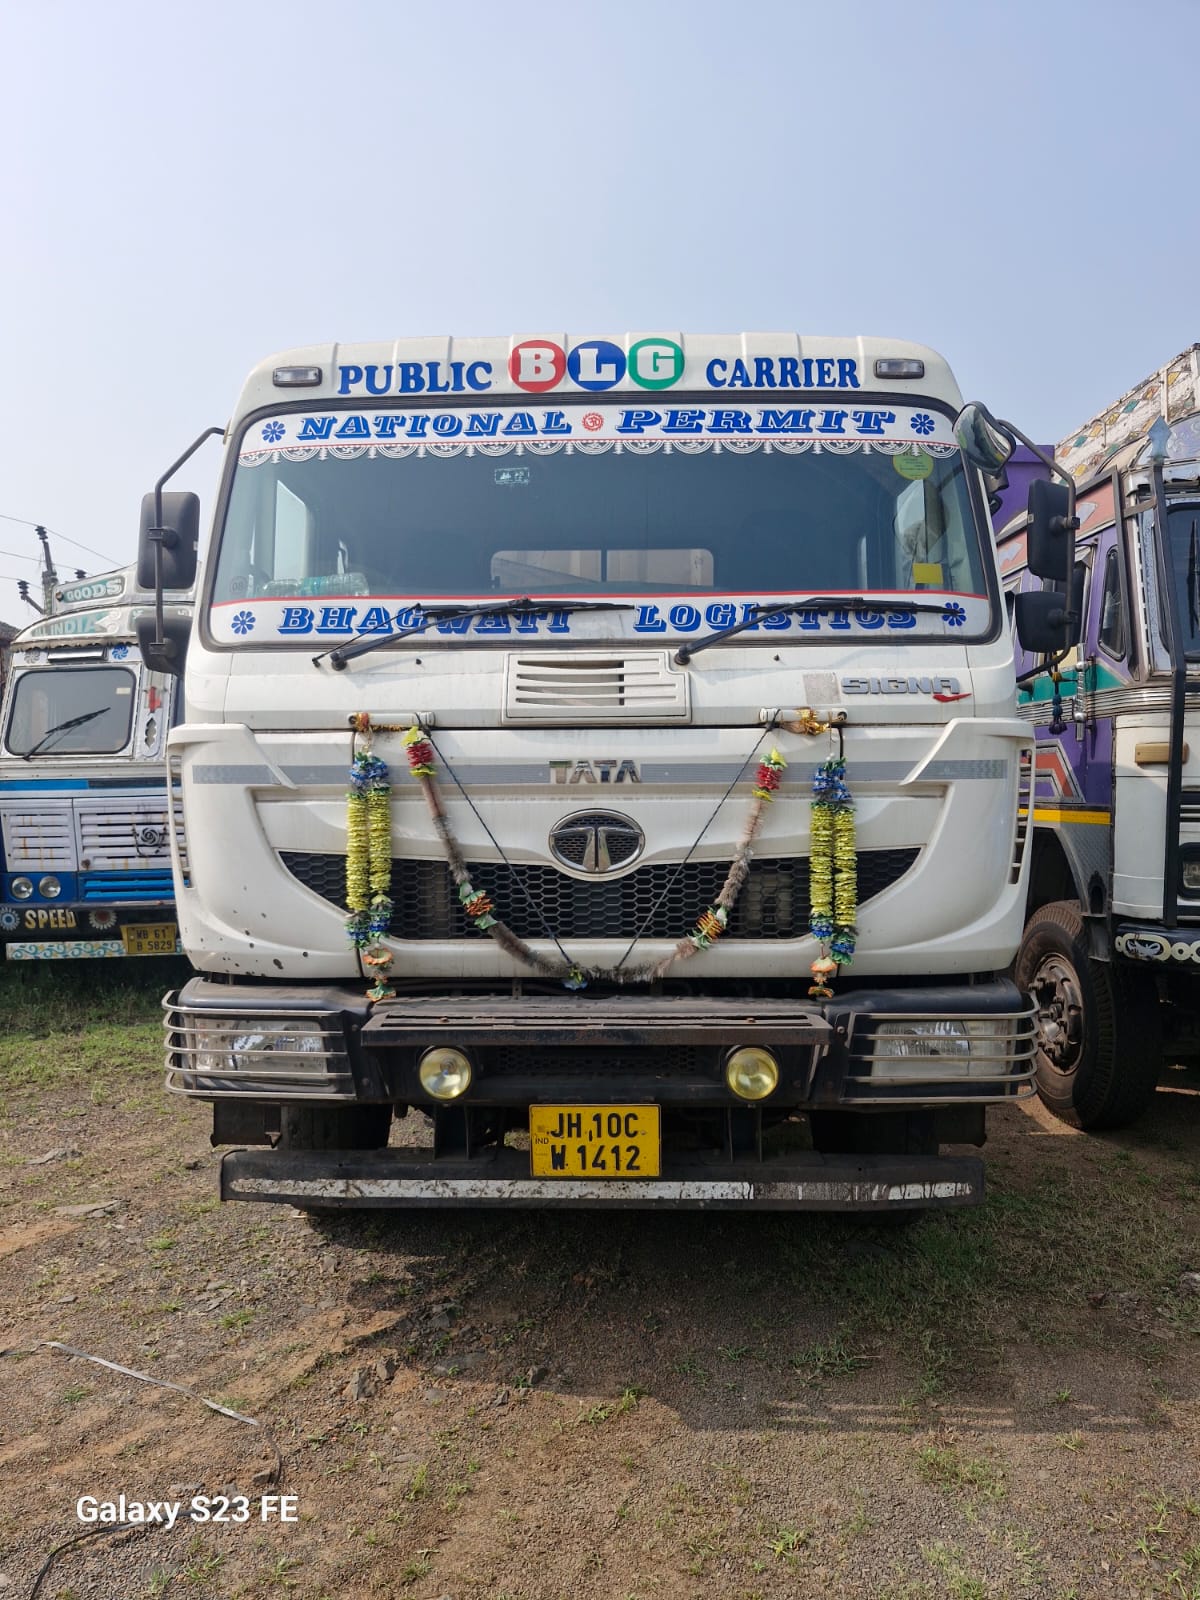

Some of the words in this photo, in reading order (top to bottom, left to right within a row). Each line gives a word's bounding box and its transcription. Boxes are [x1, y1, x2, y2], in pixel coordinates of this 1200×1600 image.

[338, 361, 492, 395] PUBLIC
[706, 357, 860, 389] CARRIER
[296, 410, 573, 439] NATIONAL
[615, 409, 896, 435] PERMIT
[66, 578, 122, 601] GOODS
[50, 614, 97, 636] INDIA
[633, 602, 917, 632] LOGISTICS
[841, 676, 960, 695] SIGNA
[548, 759, 642, 784] TATA
[25, 909, 77, 929] SPEED
[147, 940, 172, 951] 5829
[551, 1113, 582, 1138] JH
[592, 1113, 638, 1138] 10C
[535, 1137, 549, 1145] IND
[551, 1145, 566, 1170] W
[577, 1145, 640, 1171] 1412
